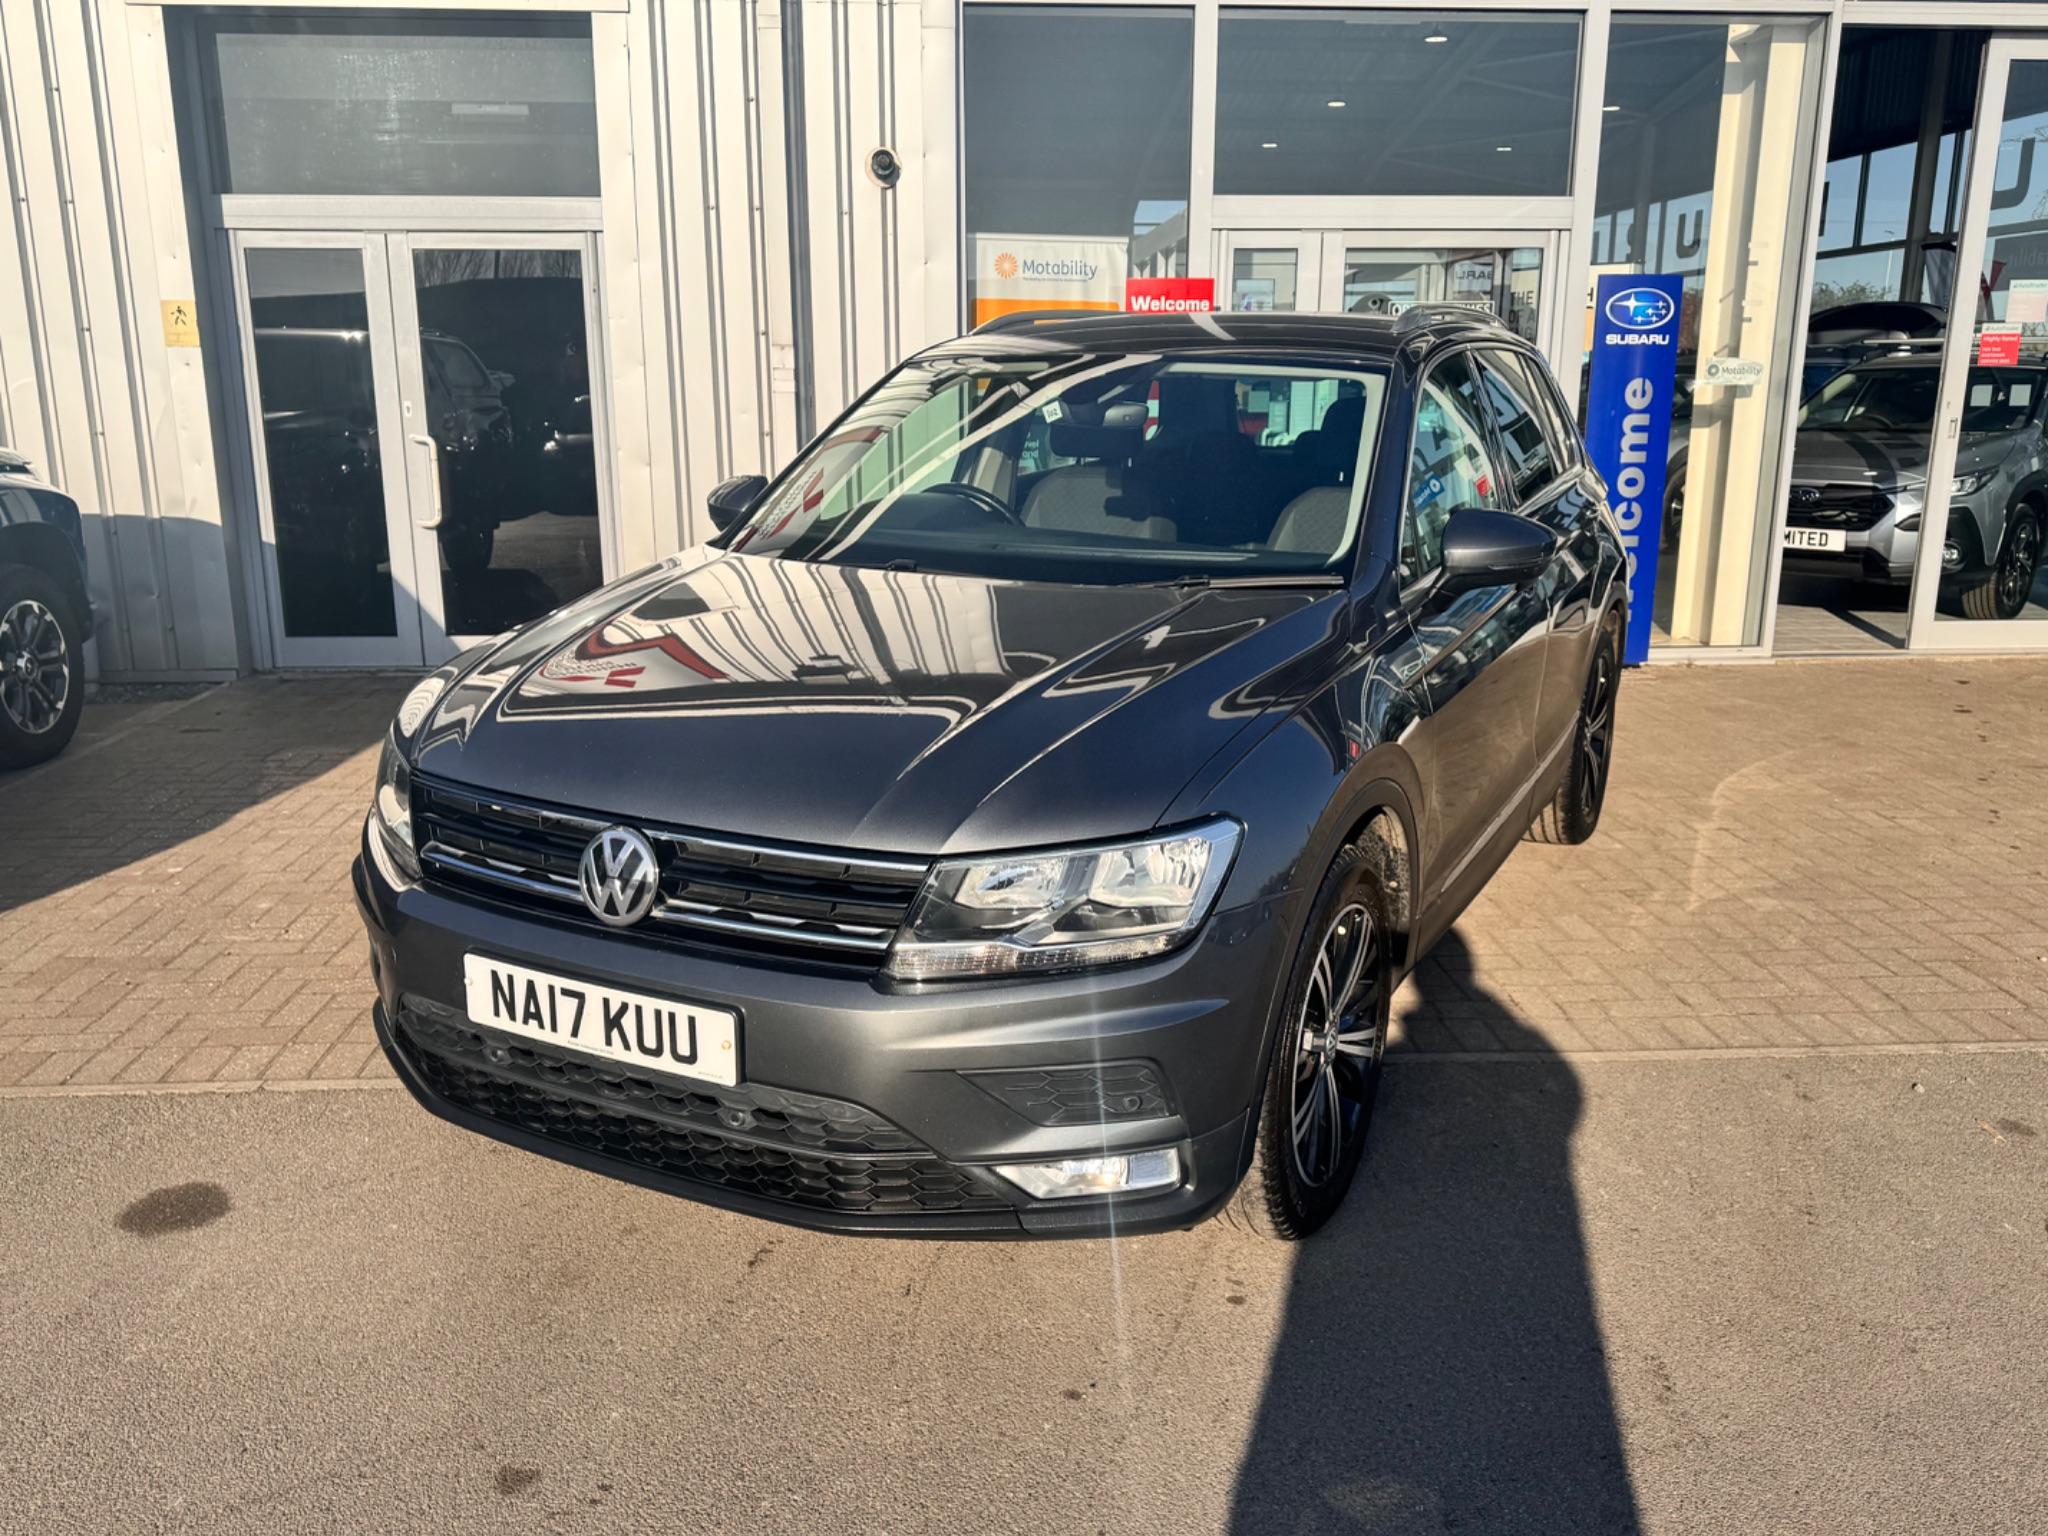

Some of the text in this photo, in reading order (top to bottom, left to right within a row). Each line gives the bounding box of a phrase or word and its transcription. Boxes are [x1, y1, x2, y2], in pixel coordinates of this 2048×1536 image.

[1022, 258, 1098, 280] Motability
[1130, 294, 1210, 312] Welcome
[1605, 333, 1670, 345] SUBARU
[490, 968, 698, 1066] NA17 KUU
